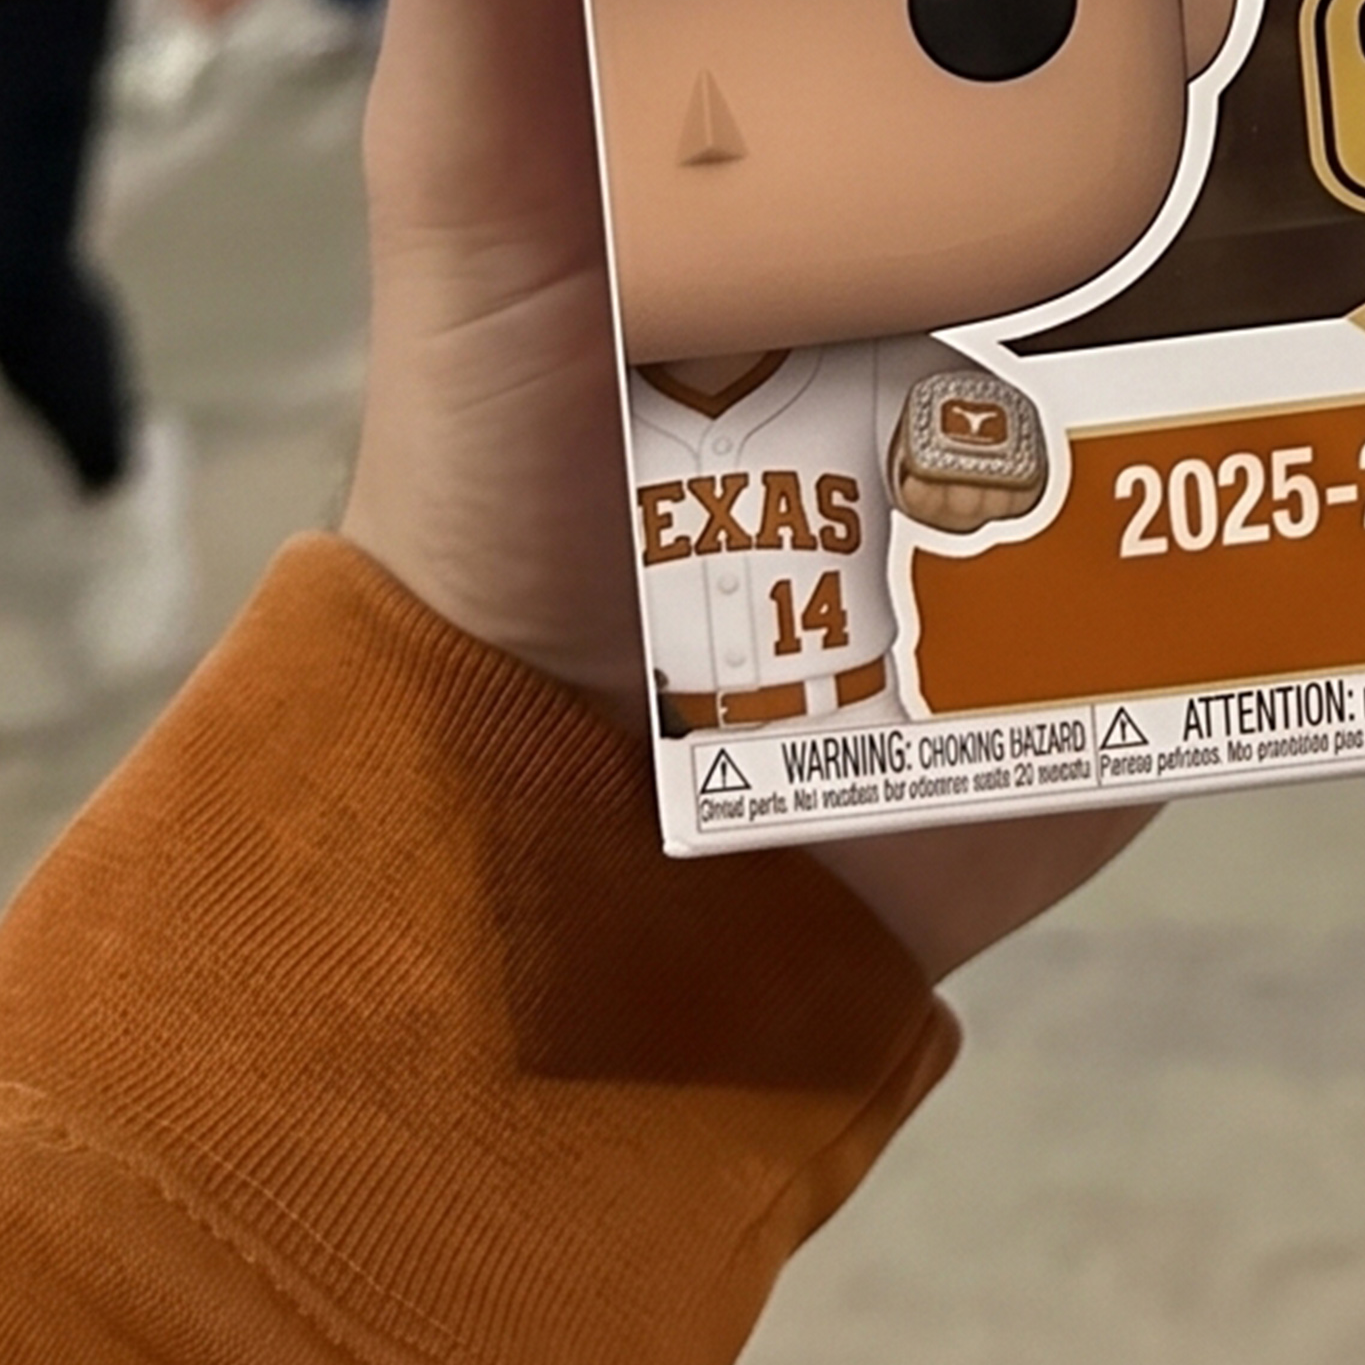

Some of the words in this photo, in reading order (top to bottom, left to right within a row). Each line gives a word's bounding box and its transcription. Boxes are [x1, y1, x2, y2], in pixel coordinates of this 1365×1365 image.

[637, 471, 861, 567] EXAS
[770, 570, 849, 656] 14
[1183, 679, 1355, 742] ATTENTION:
[782, 730, 912, 784] WARNING:
[919, 729, 1004, 770] CHOKING
